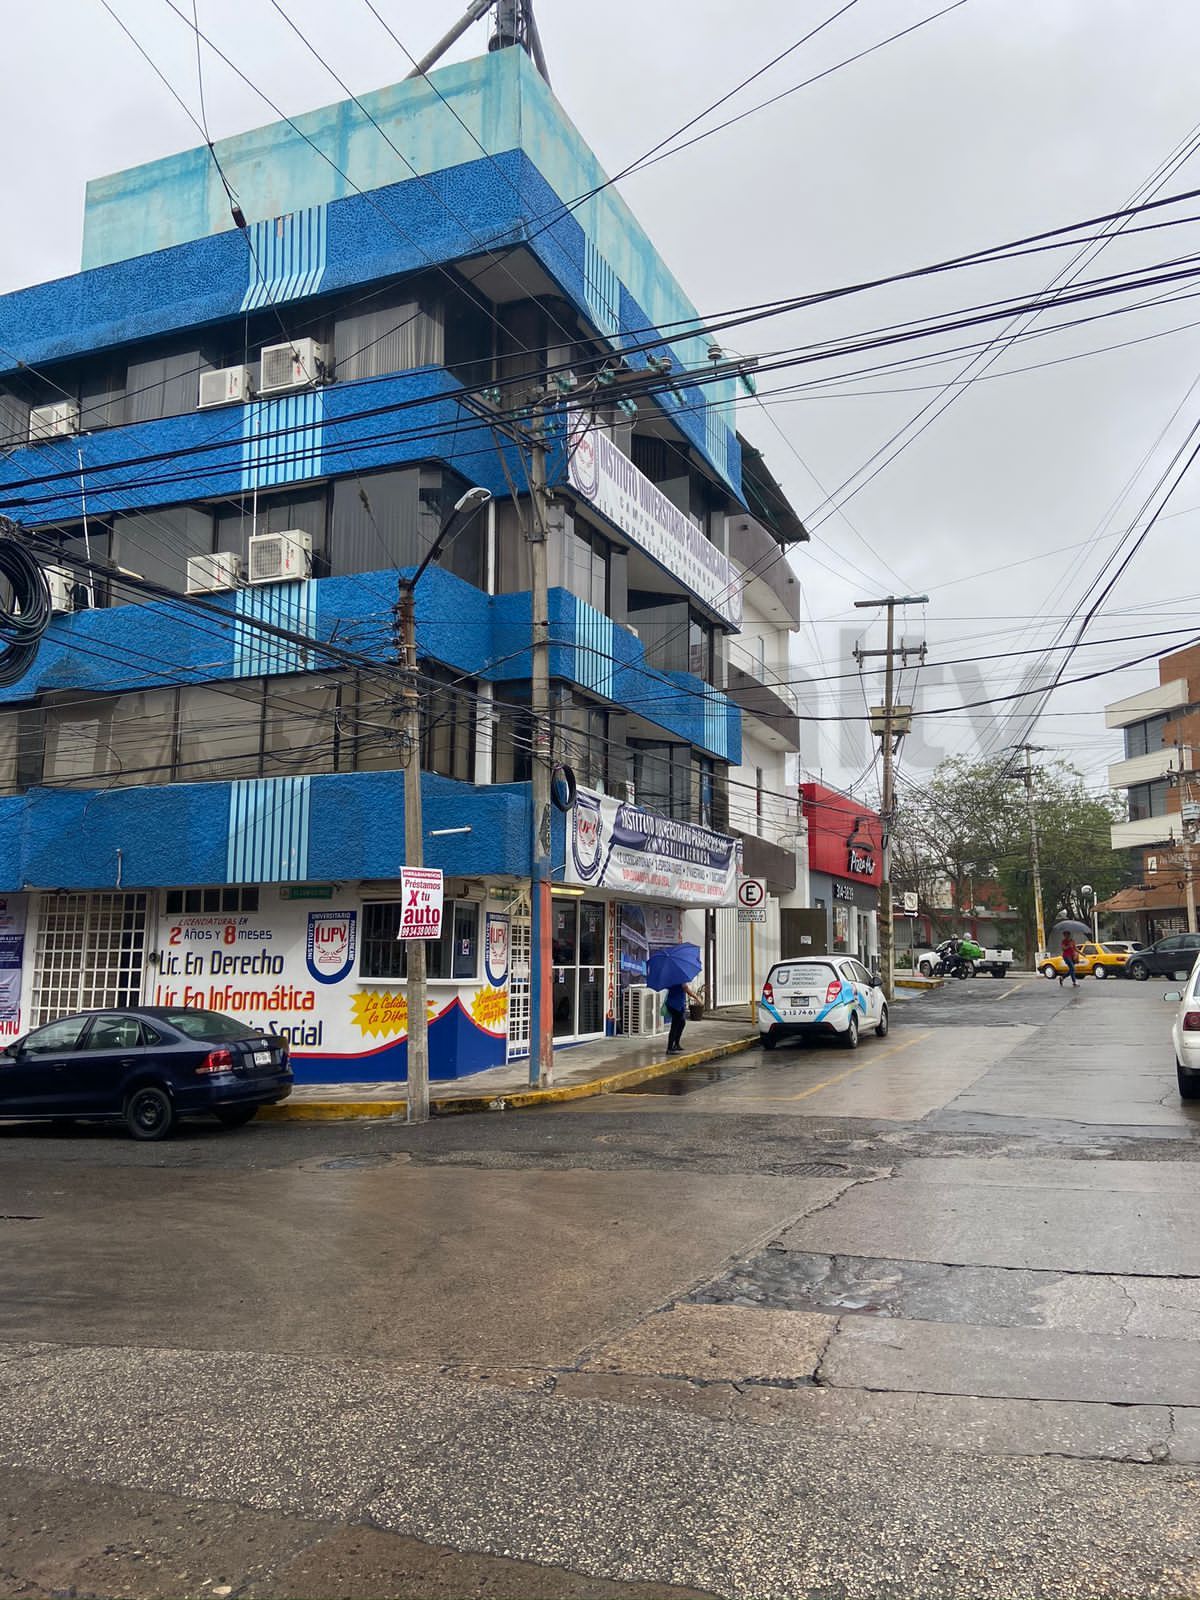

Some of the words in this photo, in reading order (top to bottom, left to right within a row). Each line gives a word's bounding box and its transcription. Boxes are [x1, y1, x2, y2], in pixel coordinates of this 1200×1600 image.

[600, 436, 638, 501] INSTITUTO
[621, 808, 654, 835] INSTITUTO
[850, 849, 865, 873] Pizza
[865, 855, 876, 875] Hut
[405, 879, 440, 889] Préstamos
[746, 885, 756, 901] E
[408, 890, 419, 906] X
[421, 891, 430, 901] tu
[178, 917, 237, 927] LICENCIATURAS
[311, 912, 350, 920] UNIVERSITARIO
[404, 905, 440, 924] auto
[169, 926, 182, 946] 2
[184, 927, 212, 940] Años
[224, 925, 236, 945] 8
[238, 929, 272, 940] meses
[159, 951, 181, 976] Lic.
[186, 951, 203, 976] En
[210, 948, 284, 976] Derecho
